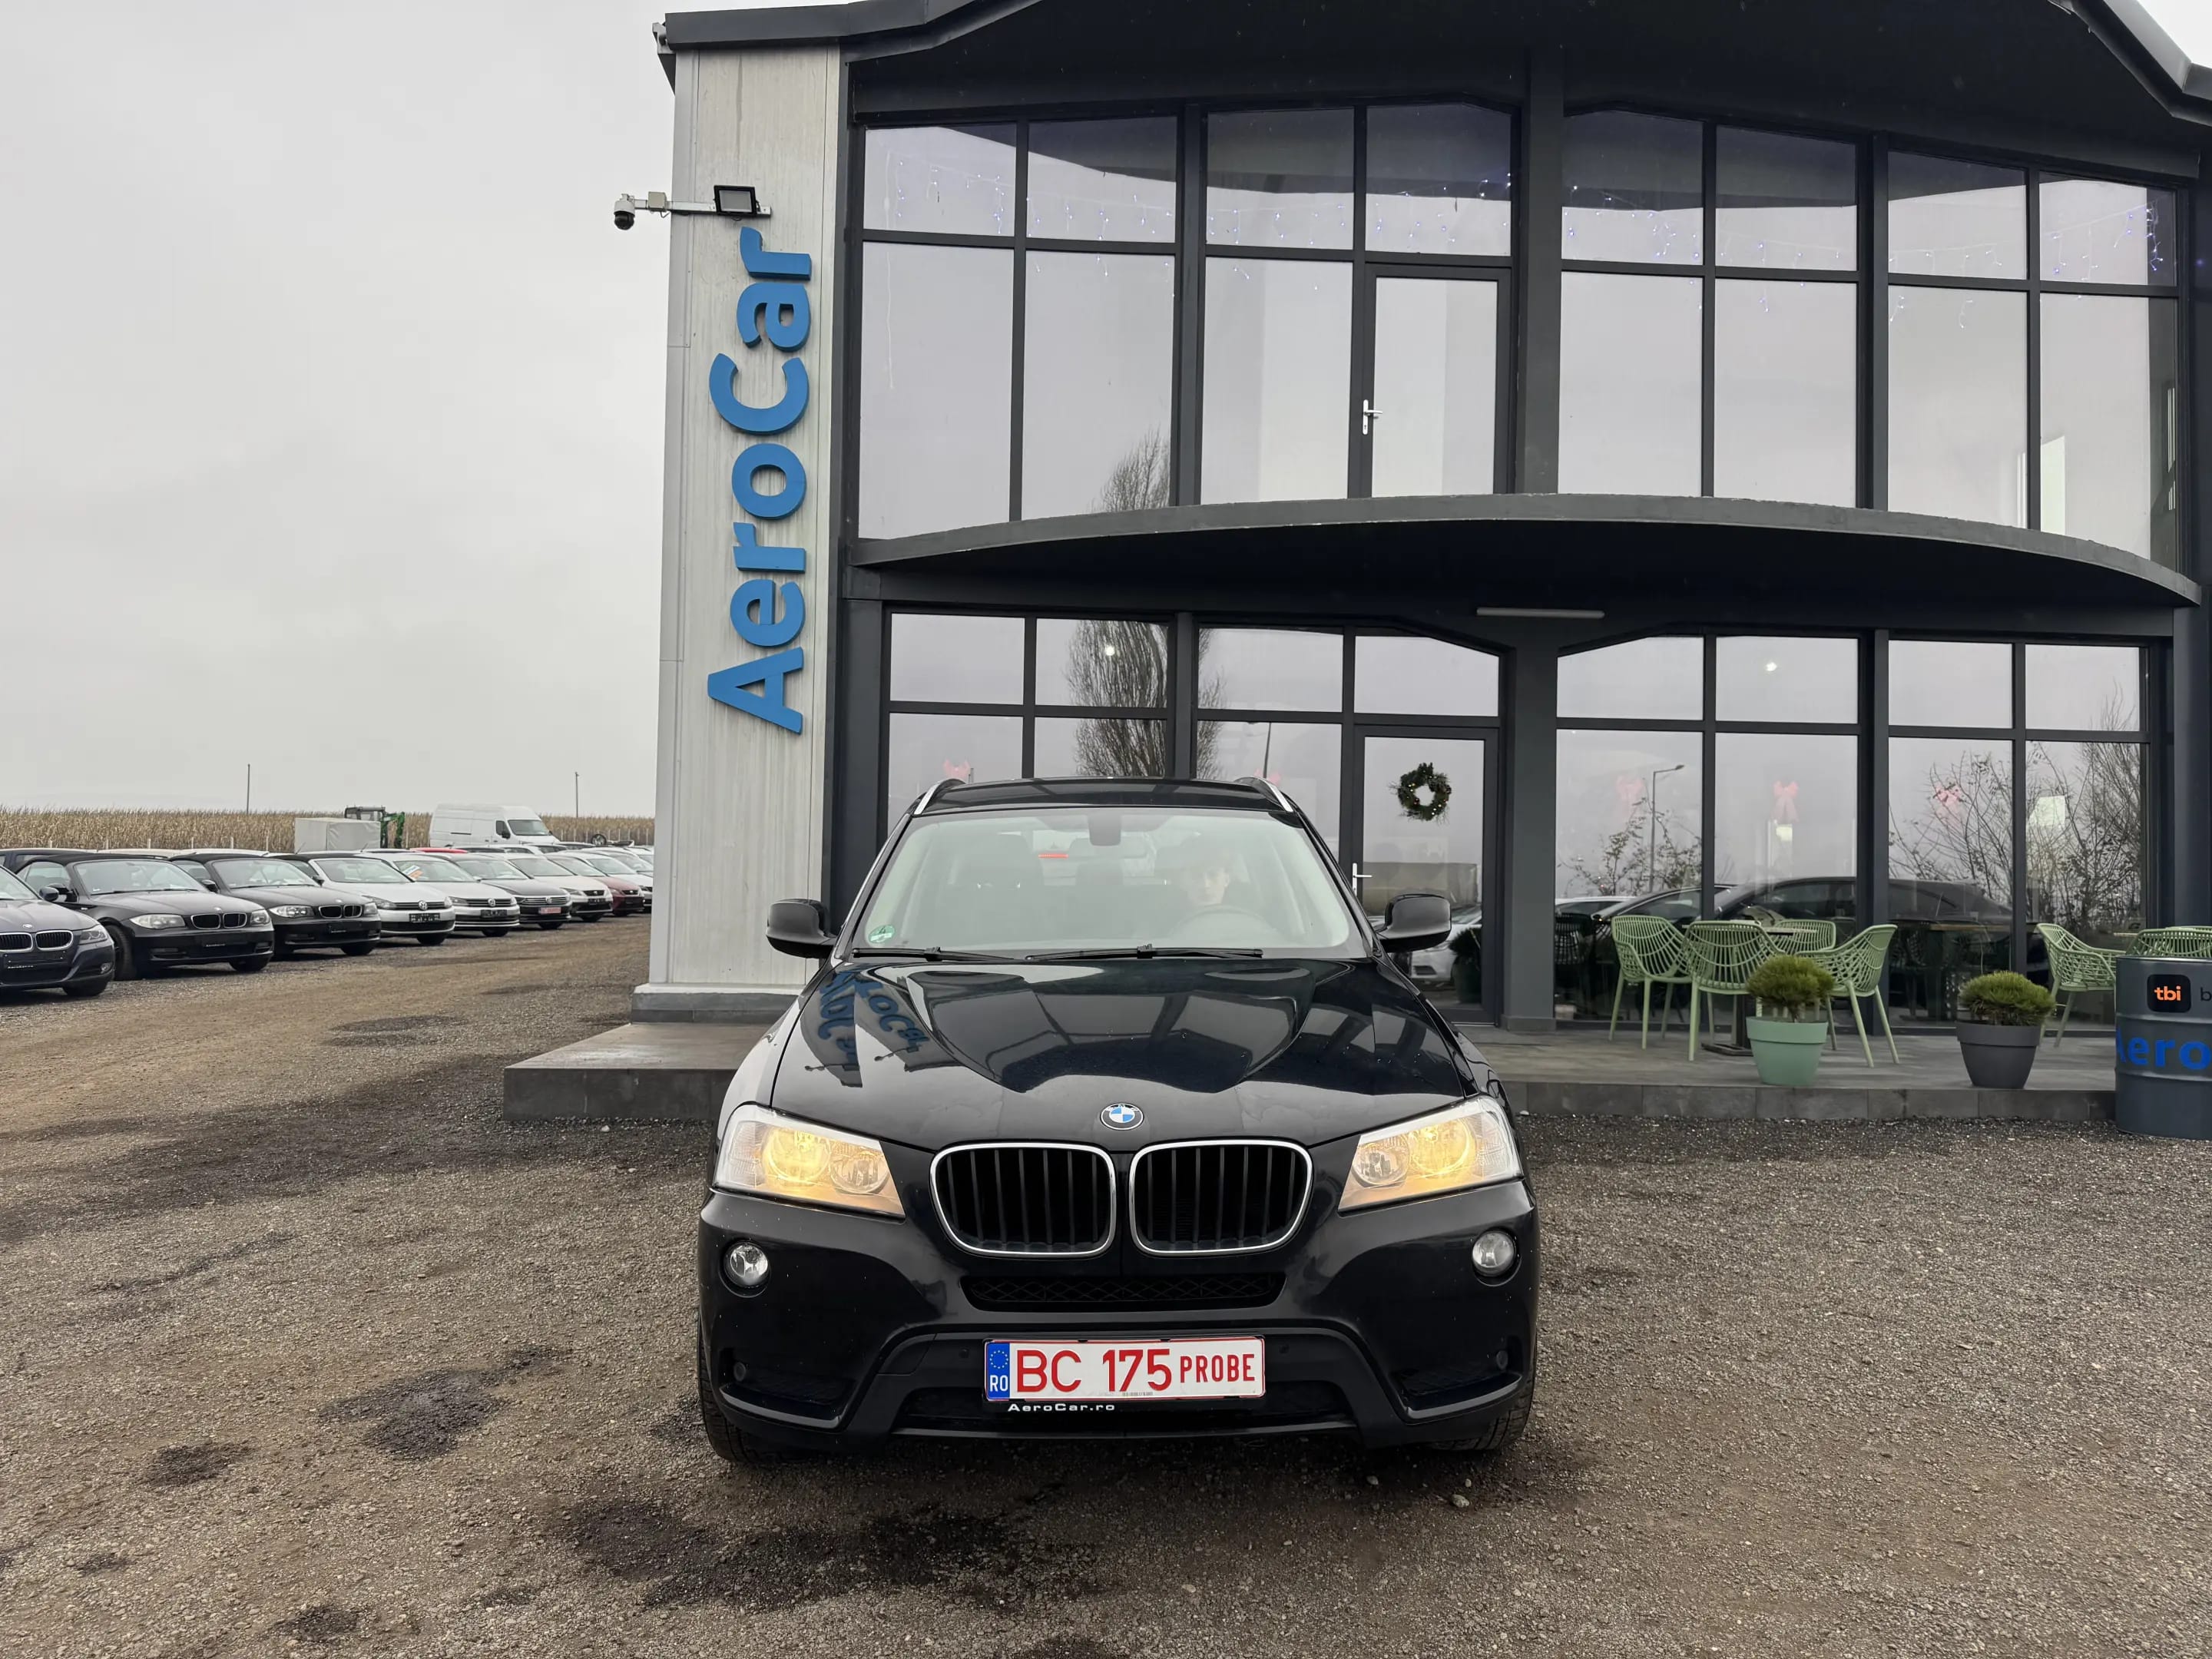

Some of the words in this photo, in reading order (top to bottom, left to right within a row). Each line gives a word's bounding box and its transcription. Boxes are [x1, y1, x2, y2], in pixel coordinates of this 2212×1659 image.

[707, 227, 812, 735] AeroCar
[2154, 985, 2181, 1001] tbi
[1017, 1349, 1081, 1392] BC
[1103, 1349, 1172, 1392] 175
[1180, 1353, 1255, 1383] PROBE
[989, 1375, 1008, 1392] RO
[1007, 1403, 1115, 1412] AeroCar.ro
